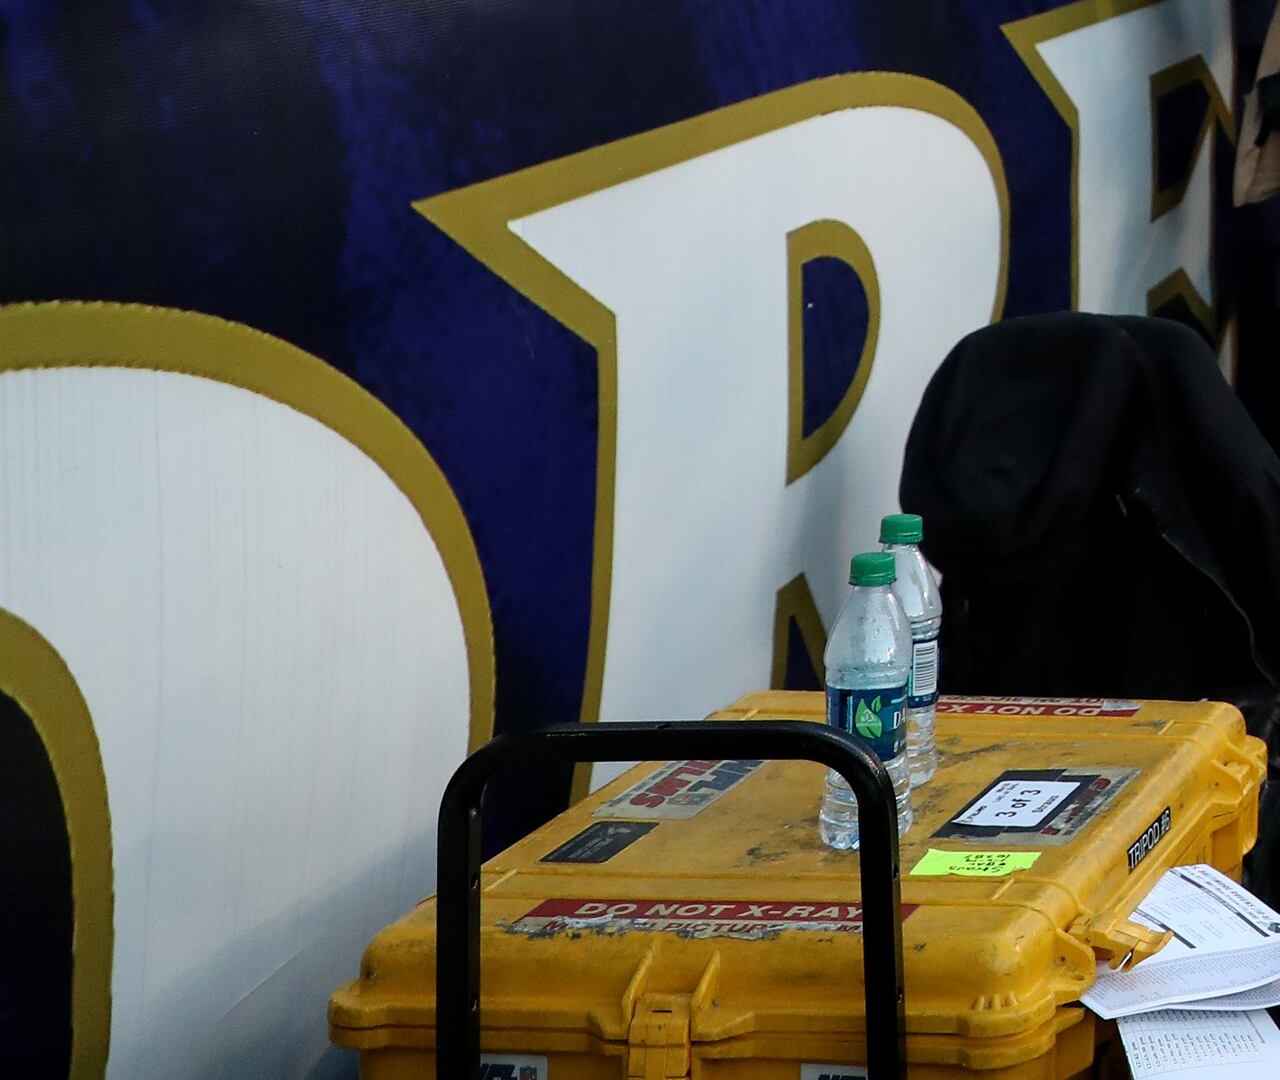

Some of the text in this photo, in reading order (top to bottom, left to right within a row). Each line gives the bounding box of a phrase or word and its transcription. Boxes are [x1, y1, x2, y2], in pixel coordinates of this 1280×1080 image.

[975, 705, 1043, 716] NOT
[1053, 707, 1102, 717] DO
[1128, 821, 1160, 869] TRIPOD
[574, 902, 863, 920] DO NOT X-RAY
[661, 922, 770, 934] PICTUR
